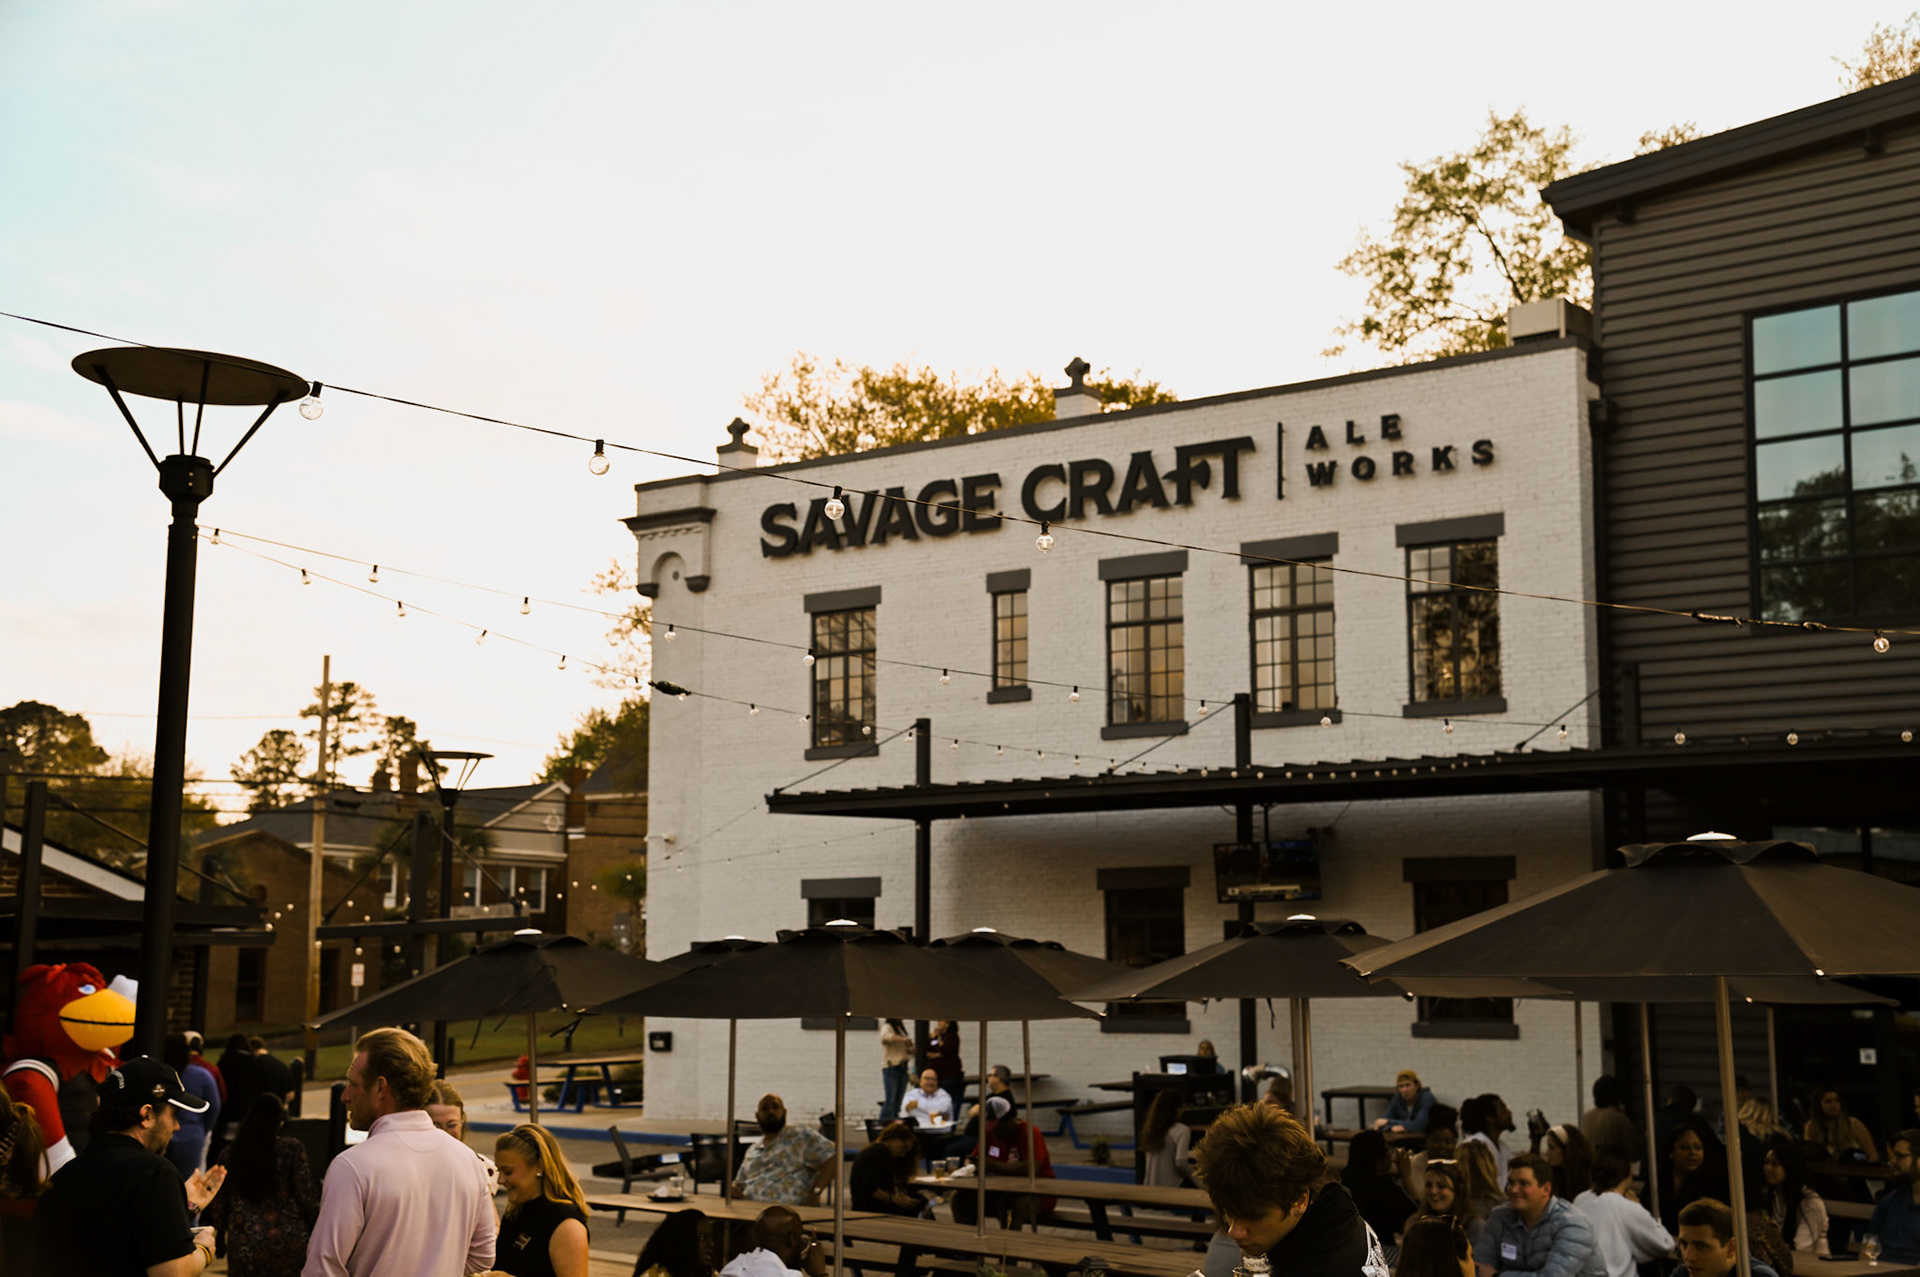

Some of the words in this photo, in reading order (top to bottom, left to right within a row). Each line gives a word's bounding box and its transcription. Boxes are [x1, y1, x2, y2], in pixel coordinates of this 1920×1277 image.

[1305, 414, 1403, 451] ALE
[1305, 439, 1495, 488] WORKS
[761, 472, 1003, 559] SAVAGE
[1021, 436, 1256, 521] CRAFT
